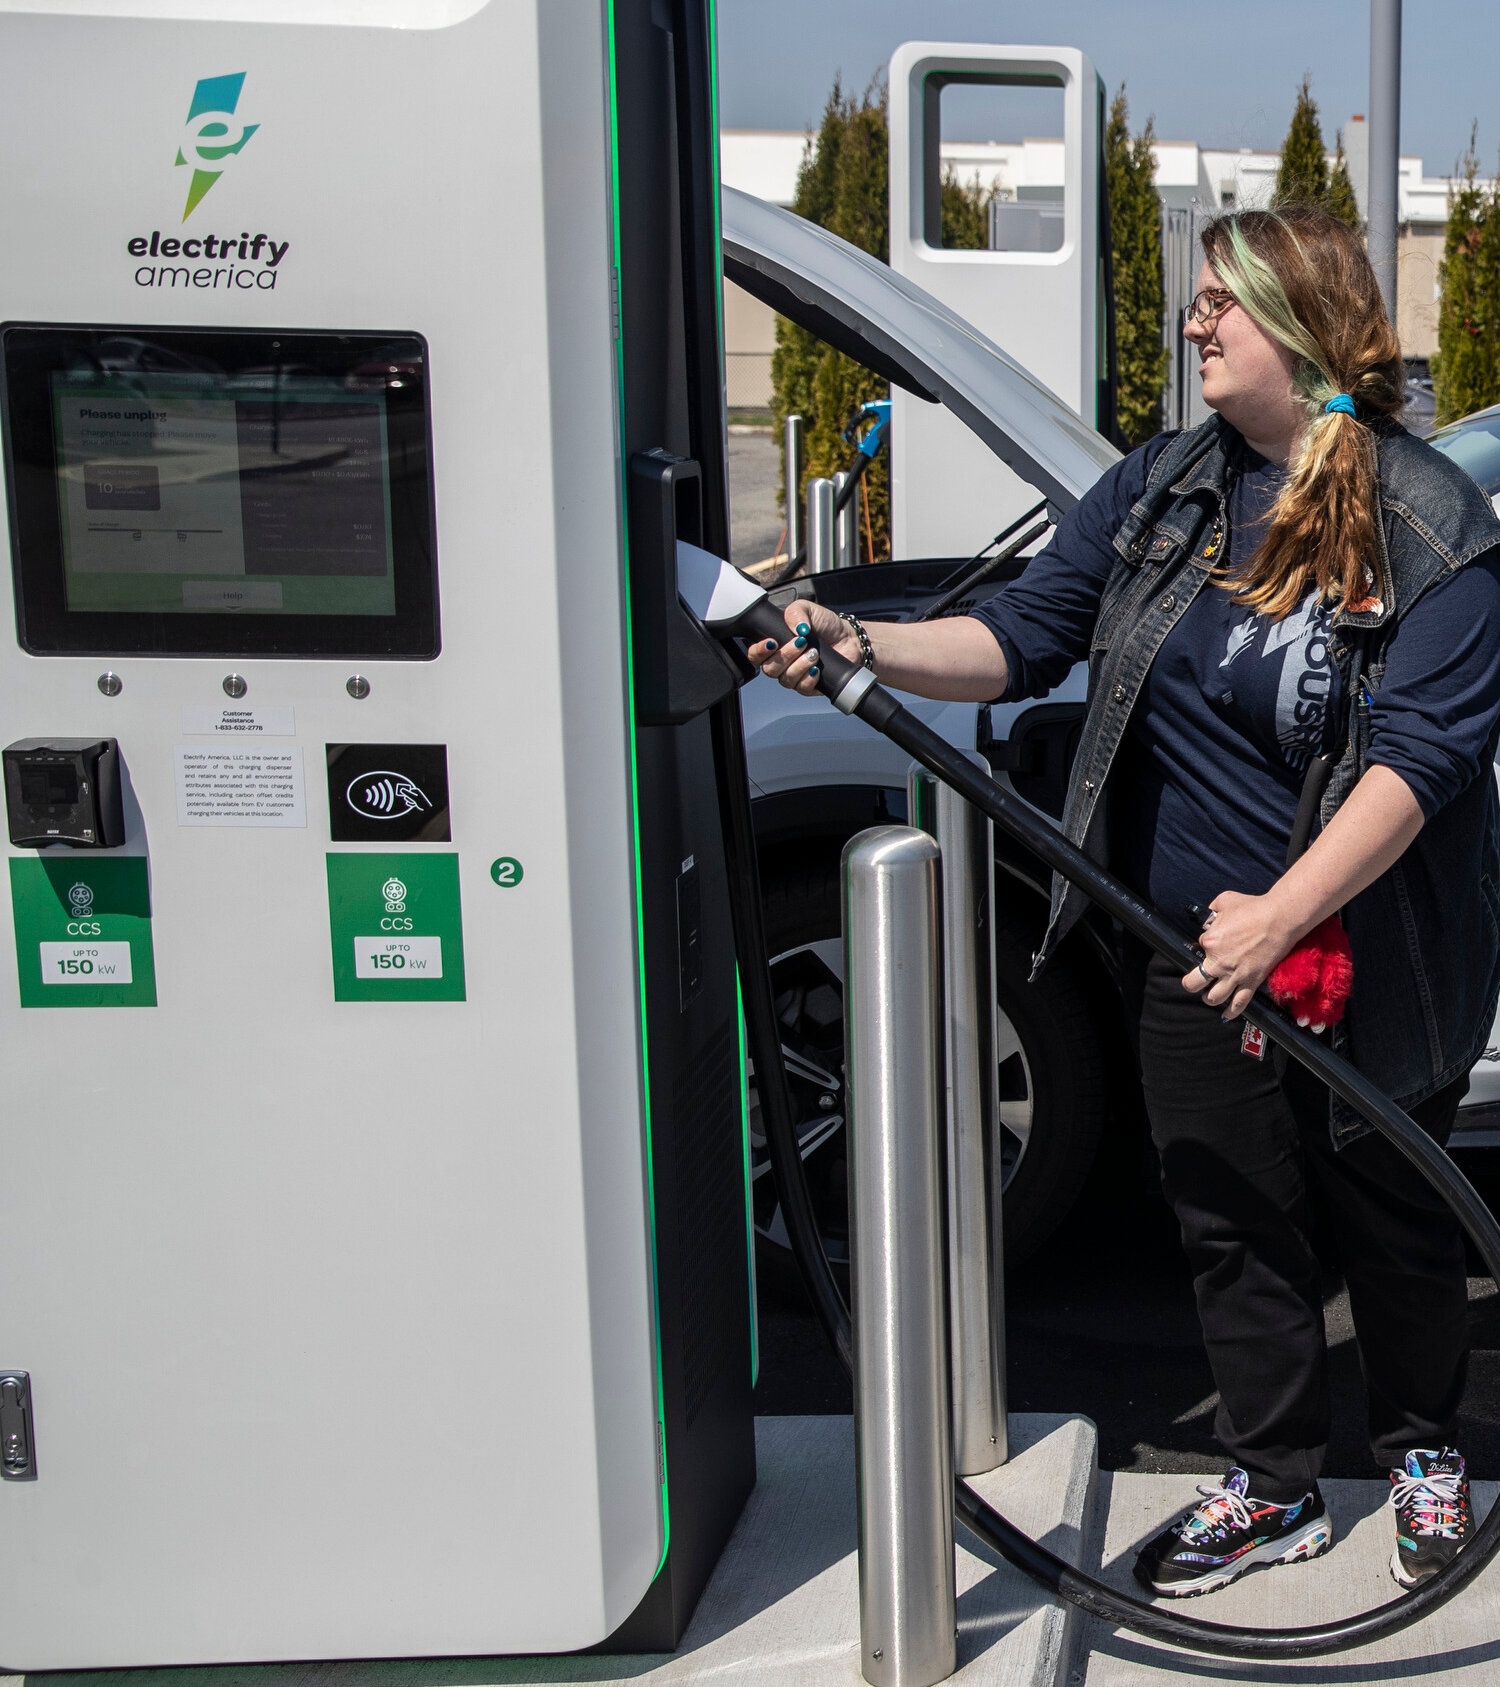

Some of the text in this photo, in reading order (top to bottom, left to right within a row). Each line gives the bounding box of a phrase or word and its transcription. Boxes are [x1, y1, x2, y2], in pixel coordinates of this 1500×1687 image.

[127, 232, 290, 266] electrify
[134, 263, 278, 291] america
[80, 408, 167, 422] Please unplug
[98, 482, 113, 494] 10
[223, 592, 243, 600] Help
[498, 862, 515, 883] 2
[66, 922, 101, 935] CCS
[380, 917, 413, 930] CCS
[58, 960, 116, 974] 150 kW
[370, 954, 427, 969] 150 kW
